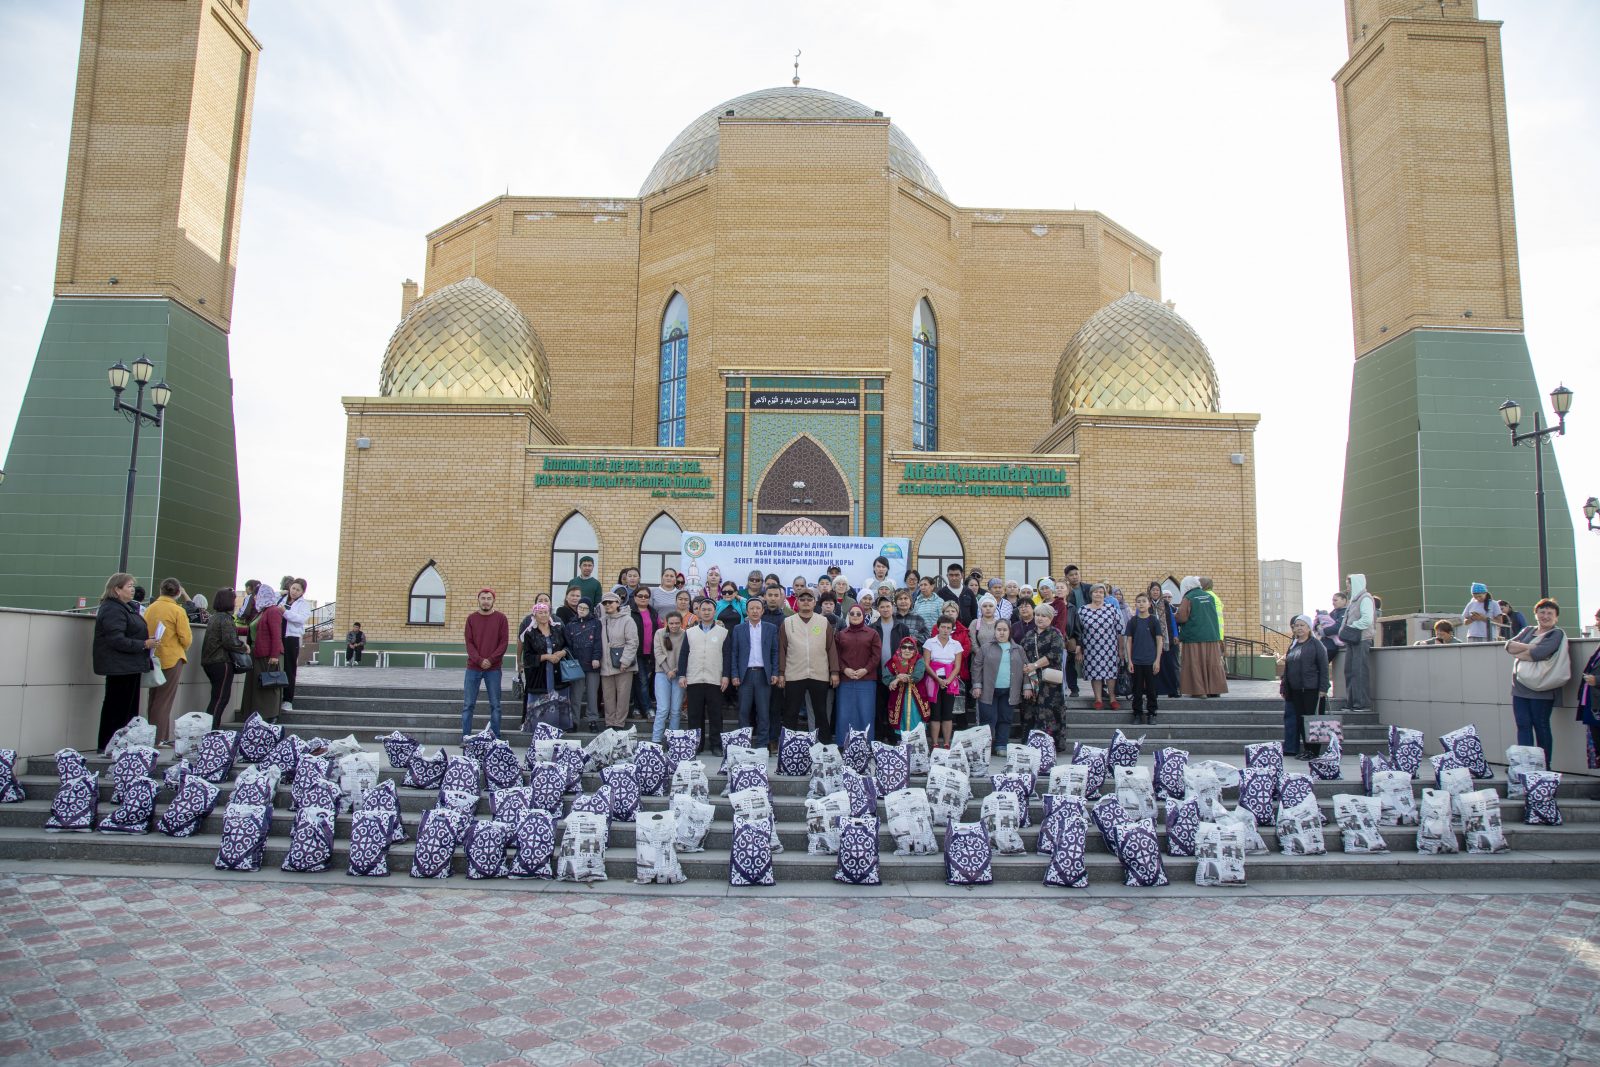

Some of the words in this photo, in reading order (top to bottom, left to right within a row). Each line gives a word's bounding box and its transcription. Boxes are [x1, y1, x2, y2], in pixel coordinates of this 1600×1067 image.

[904, 463, 947, 481] Абай
[897, 483, 967, 497] атындағы
[967, 484, 1025, 498] орталық
[1027, 484, 1071, 498] мешіті
[714, 540, 752, 549] ҚАЗАҚСТАН
[753, 541, 811, 549] МҰСЫЛМАНДАРЫ
[812, 542, 828, 550] ДІНИ
[804, 550, 833, 558] ӨКІЛДІГІ
[772, 558, 834, 566] ҚАЙЫРЫМДЫЛЫҚ
